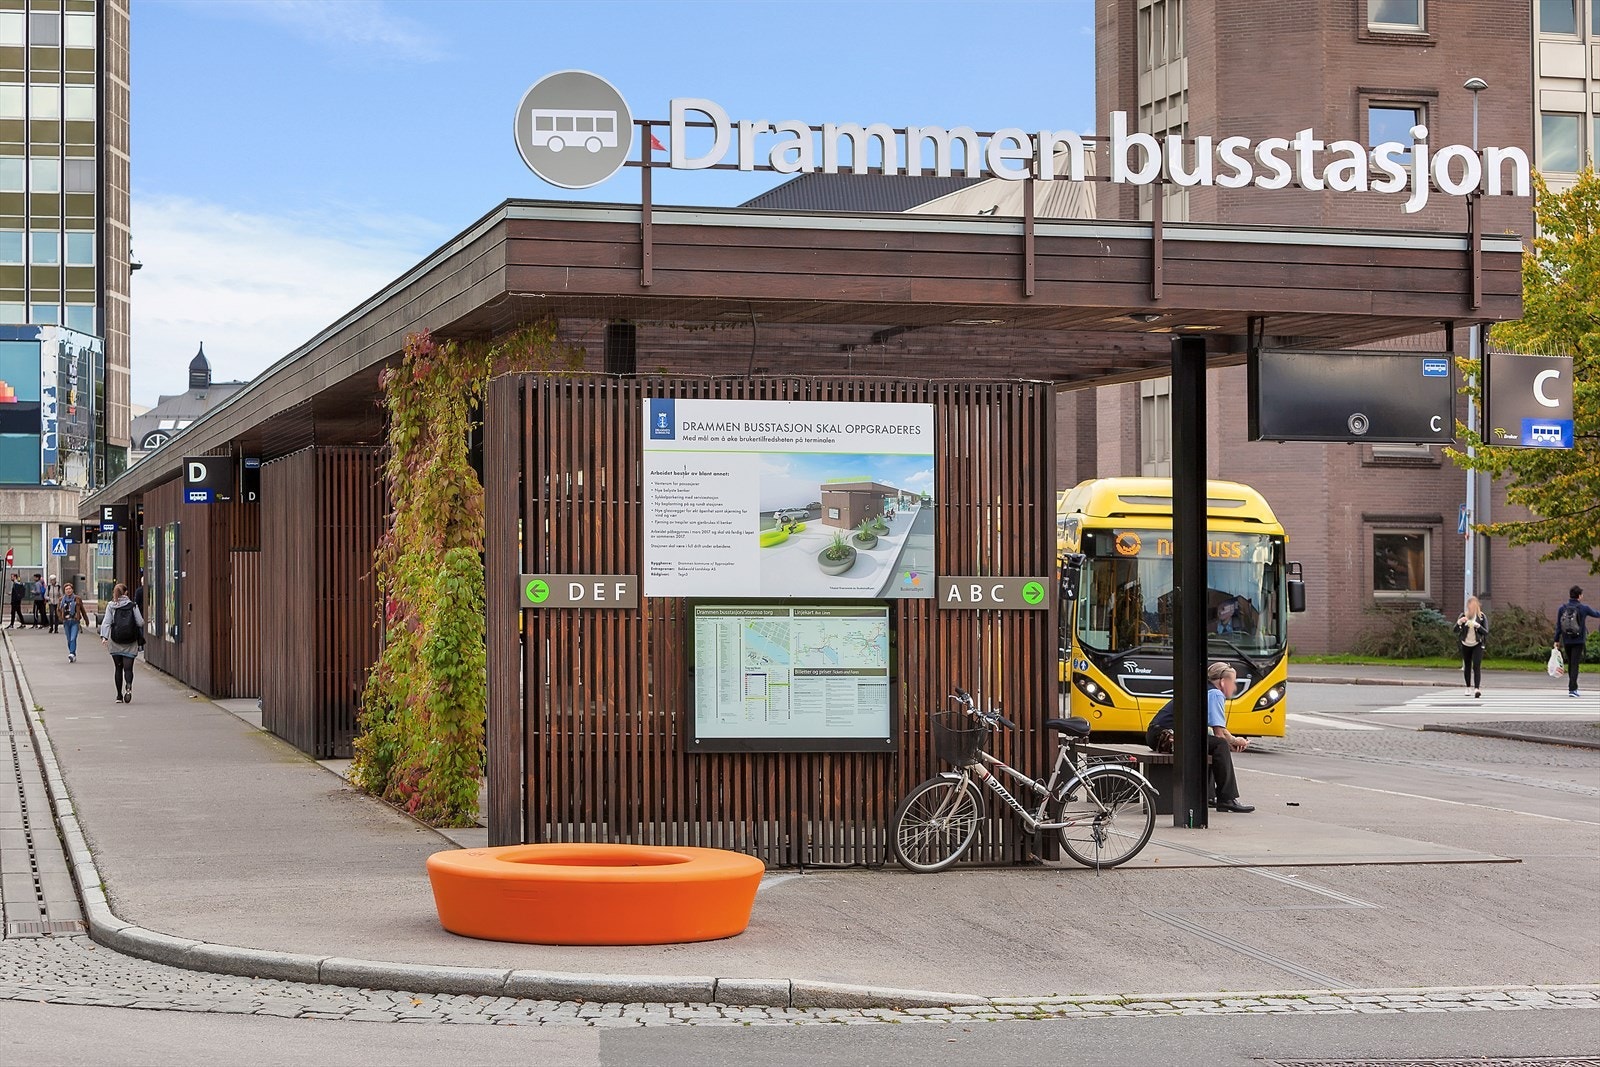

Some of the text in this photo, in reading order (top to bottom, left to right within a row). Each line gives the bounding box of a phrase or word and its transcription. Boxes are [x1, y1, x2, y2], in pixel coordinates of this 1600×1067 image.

[669, 97, 1530, 214] Drammen busstasjon
[1532, 369, 1560, 407] C
[682, 422, 740, 431] DRAMMEN
[744, 422, 813, 433] BUSSTASJON
[816, 424, 842, 434] SKAL
[845, 424, 921, 435] OPPGRADERES
[1429, 415, 1442, 432] C
[188, 462, 207, 482] D
[248, 492, 256, 500] D
[104, 508, 113, 520] E
[65, 528, 72, 536] F
[1157, 538, 1242, 558] nuss
[568, 582, 626, 601] D E F
[947, 584, 1004, 602] A B C
